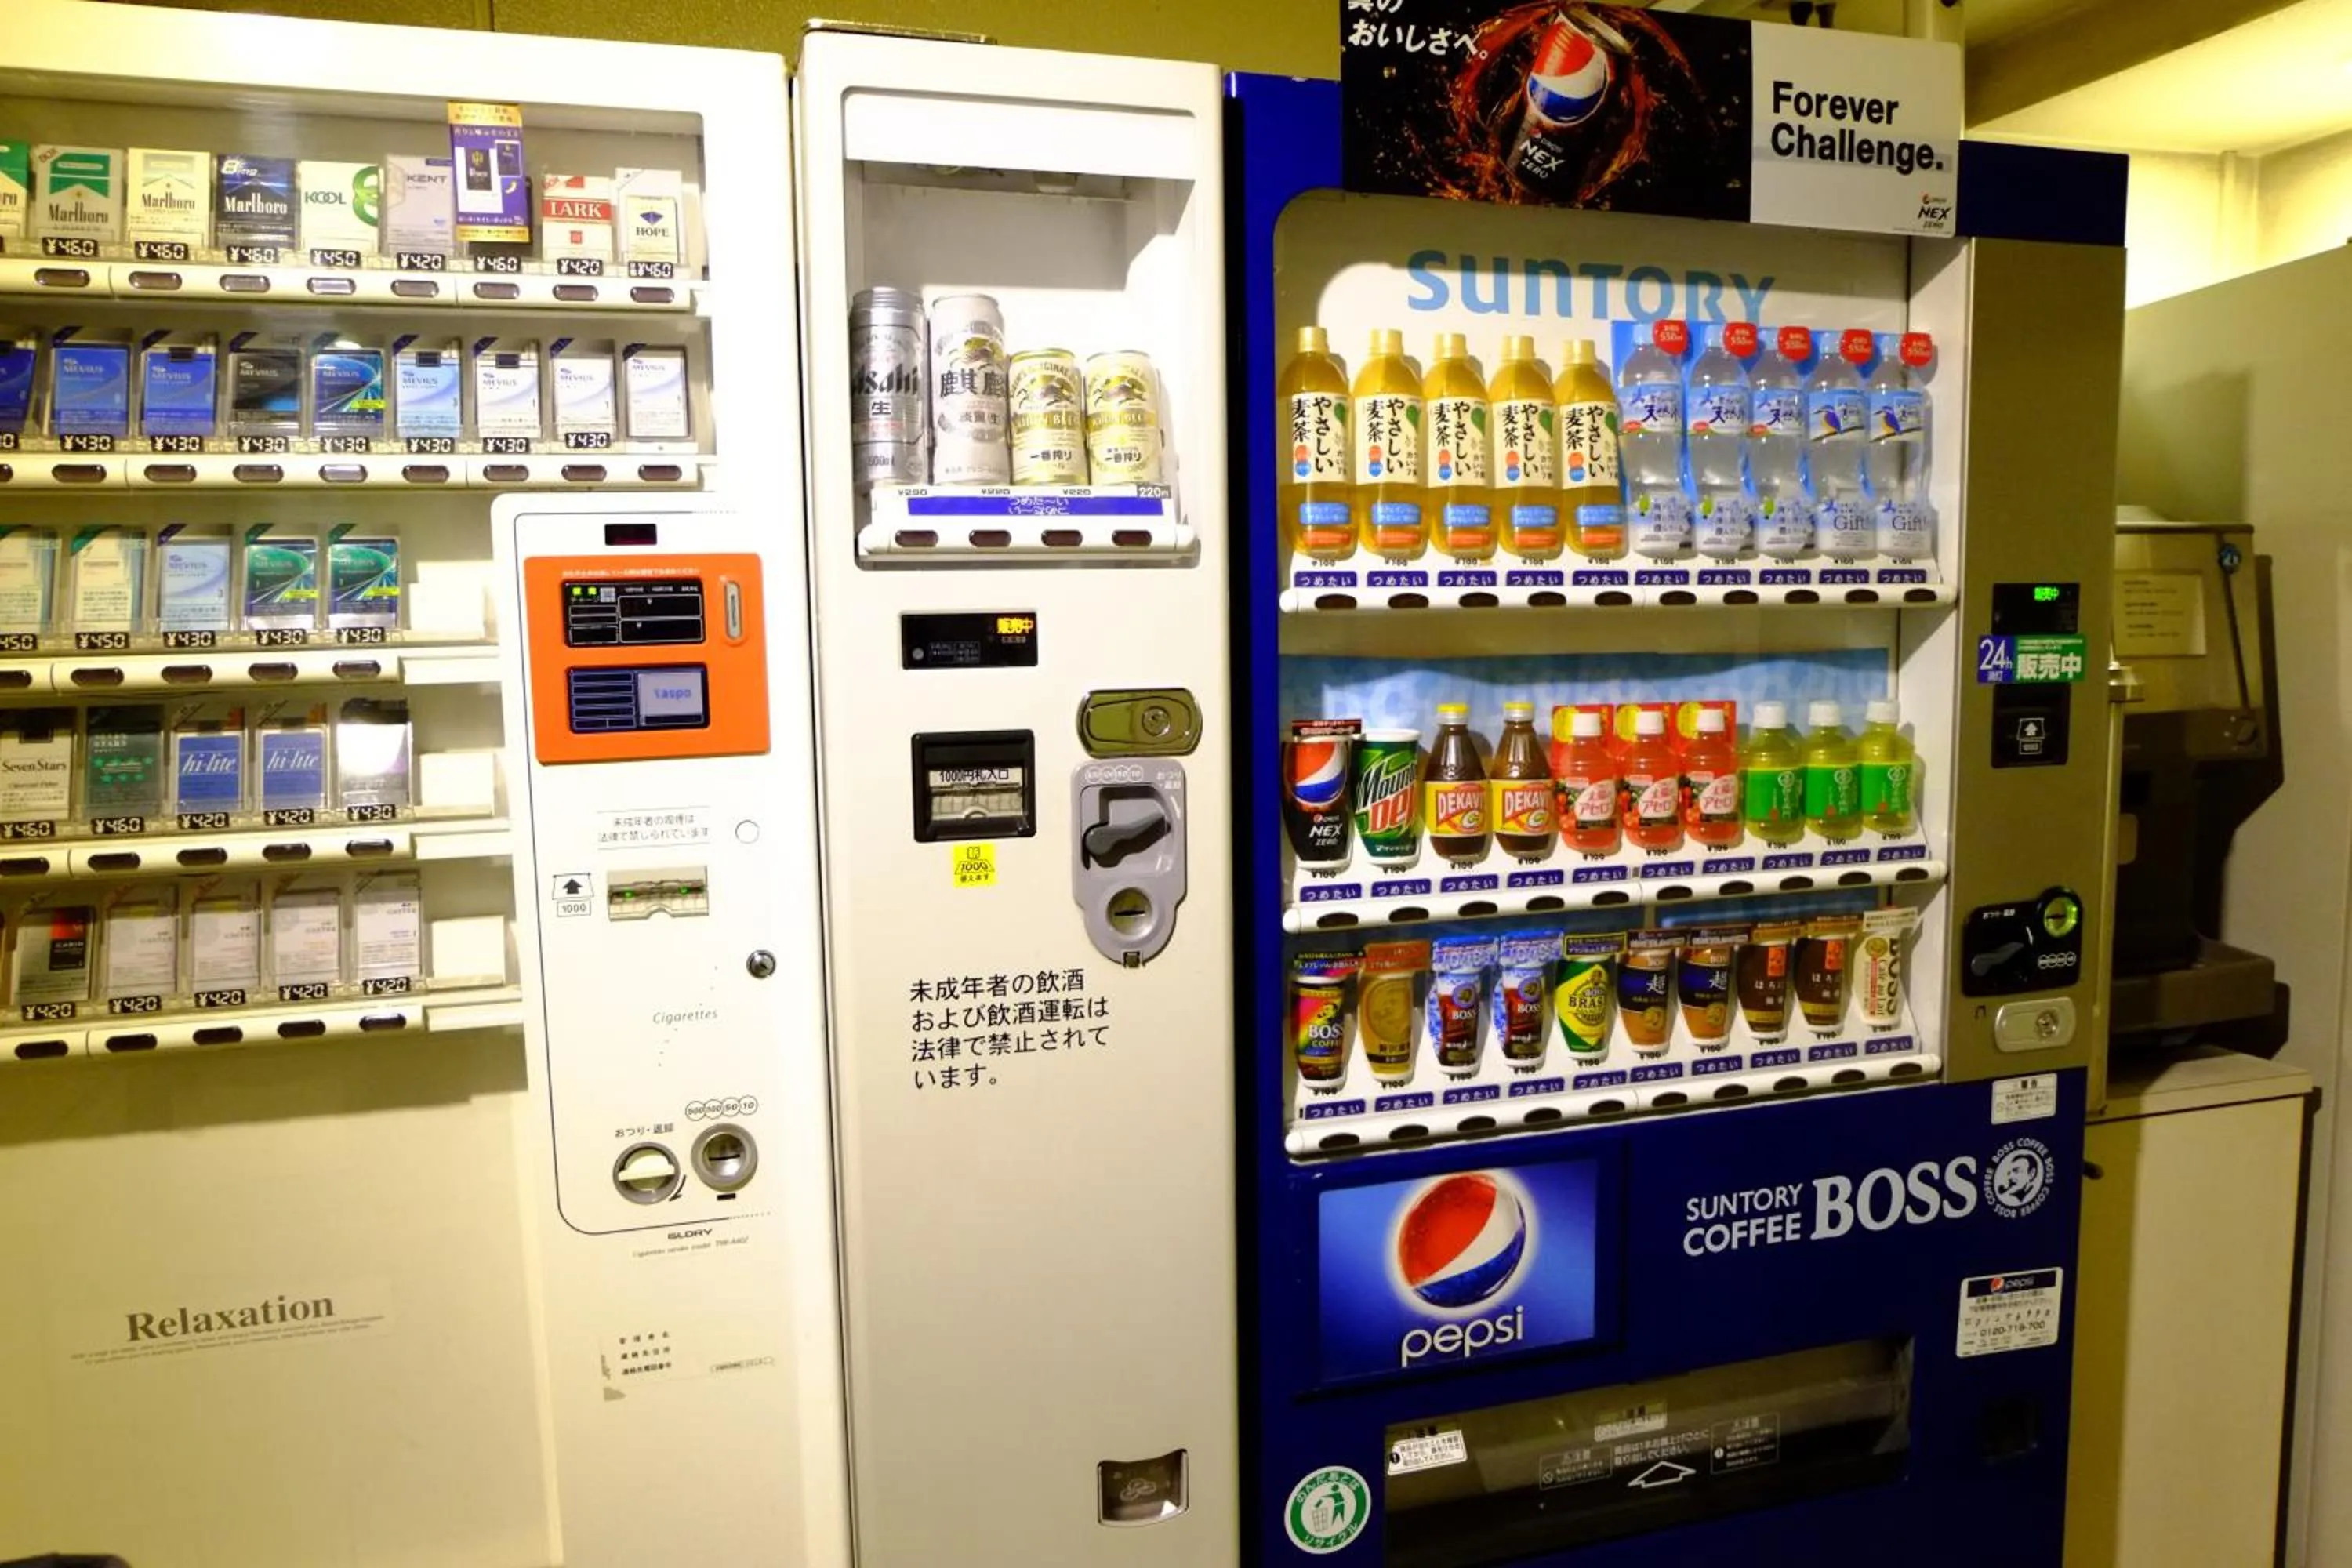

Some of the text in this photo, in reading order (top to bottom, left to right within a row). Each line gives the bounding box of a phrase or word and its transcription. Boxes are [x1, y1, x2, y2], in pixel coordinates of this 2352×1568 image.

[1348, 18, 1489, 60] おいしさへ。
[1773, 81, 1899, 125] Forever
[1519, 140, 1566, 172] NEX
[1771, 122, 1944, 176] Challenge.
[1521, 158, 1548, 179] ZERO
[406, 173, 448, 186] KENT
[141, 191, 196, 210] Marlboro
[224, 191, 288, 215] Marlboro
[304, 190, 347, 205] KOOL
[49, 201, 109, 224] Marlboro
[550, 201, 603, 219] LARK
[1918, 206, 1951, 220] NEX
[636, 226, 669, 238] HOPE
[45, 238, 95, 256] ¥460
[138, 242, 186, 260] ¥460
[229, 247, 275, 263] ¥460
[313, 251, 361, 267] ¥450
[401, 255, 442, 271] ¥420
[477, 257, 518, 272] ¥460
[561, 260, 600, 275] ¥420
[871, 401, 891, 416] 生
[1292, 399, 1312, 442] 麦茶
[1367, 401, 1385, 442] 麦茶
[1434, 403, 1451, 446] 麦茶
[1502, 405, 1519, 448] 麦茶
[1565, 408, 1584, 448] 麦茶
[568, 434, 607, 448] ¥430
[1312, 397, 1333, 473] やさしい
[1385, 397, 1406, 473] やさしい
[1452, 401, 1471, 477] やさしい
[1520, 403, 1538, 477] やさしい
[1585, 406, 1605, 477] やさしい
[64, 435, 111, 452] ¥430
[155, 437, 200, 452] ¥430
[241, 437, 285, 452] ¥430
[323, 437, 367, 452] ¥430
[410, 438, 451, 452] ¥430
[487, 438, 526, 452] ¥430
[1030, 450, 1072, 461] 一番搾り
[80, 634, 125, 648] ¥450
[164, 633, 212, 648] ¥430
[260, 630, 304, 644] ¥430
[340, 628, 382, 643] ¥430
[2016, 652, 2082, 680] 販売中
[654, 688, 691, 700] taspo
[2, 758, 67, 774] Seven Stars
[183, 751, 236, 774] hi-lite
[268, 747, 318, 771] hi-lite
[268, 810, 310, 824] ¥420
[351, 805, 390, 819] ¥430
[95, 818, 141, 833] ¥460
[182, 815, 226, 828] ¥420
[1309, 824, 1343, 837] NEX
[961, 862, 988, 871] 1000
[562, 903, 586, 913] 1000
[282, 985, 324, 999] ¥420
[367, 978, 406, 993] ¥420
[909, 968, 1084, 1003] 未成年者の飲酒
[1646, 974, 1666, 995] 超
[113, 998, 158, 1011] ¥420
[199, 992, 241, 1005] ¥420
[652, 1009, 718, 1025] Cigarettes
[912, 996, 1109, 1033] および飲酒運転は
[912, 1025, 1109, 1062] 法律で禁止されて
[914, 1063, 997, 1090] います。
[1686, 1183, 1803, 1222] SUNTORY
[1809, 1156, 1977, 1241] BOSS
[667, 1229, 713, 1240] GLORY
[1683, 1212, 1801, 1256] COFFEE
[125, 1294, 336, 1341] Relaxation
[1401, 1305, 1524, 1368] pepsi
